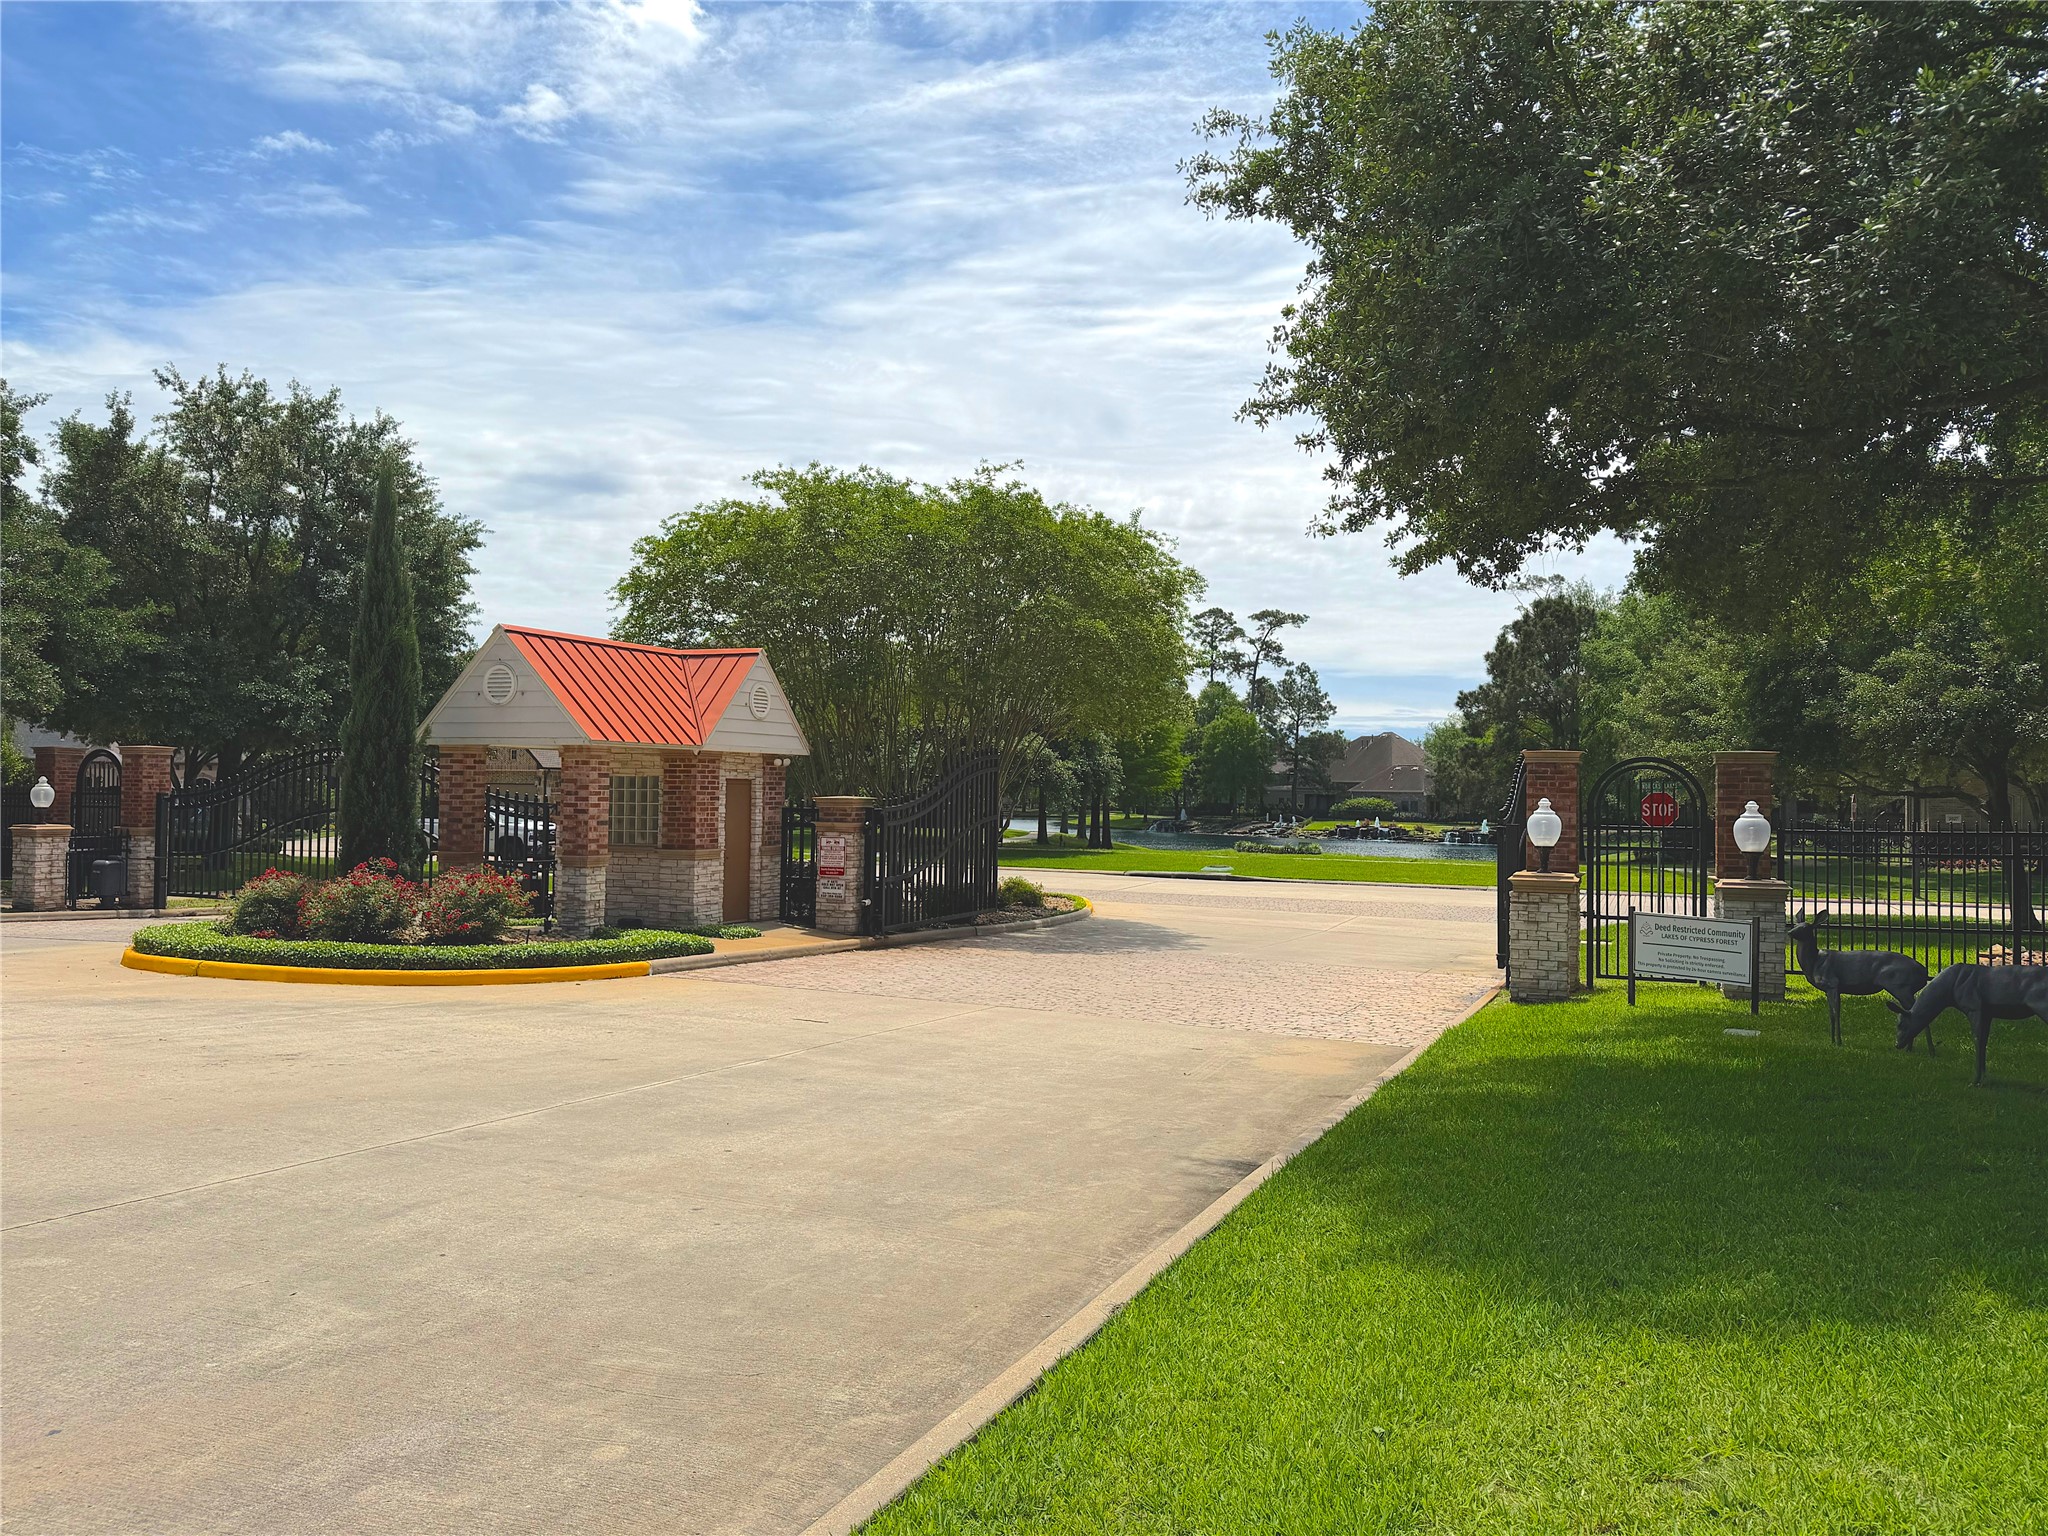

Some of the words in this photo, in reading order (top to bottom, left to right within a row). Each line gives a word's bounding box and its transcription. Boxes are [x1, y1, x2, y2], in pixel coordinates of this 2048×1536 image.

[1642, 803, 1674, 817] STOP
[1654, 923, 1671, 932] Deed
[1672, 924, 1706, 935] Restricted
[1707, 928, 1746, 940] Community
[1689, 935, 1715, 944] CYPRESS
[1716, 938, 1738, 946] FOREST
